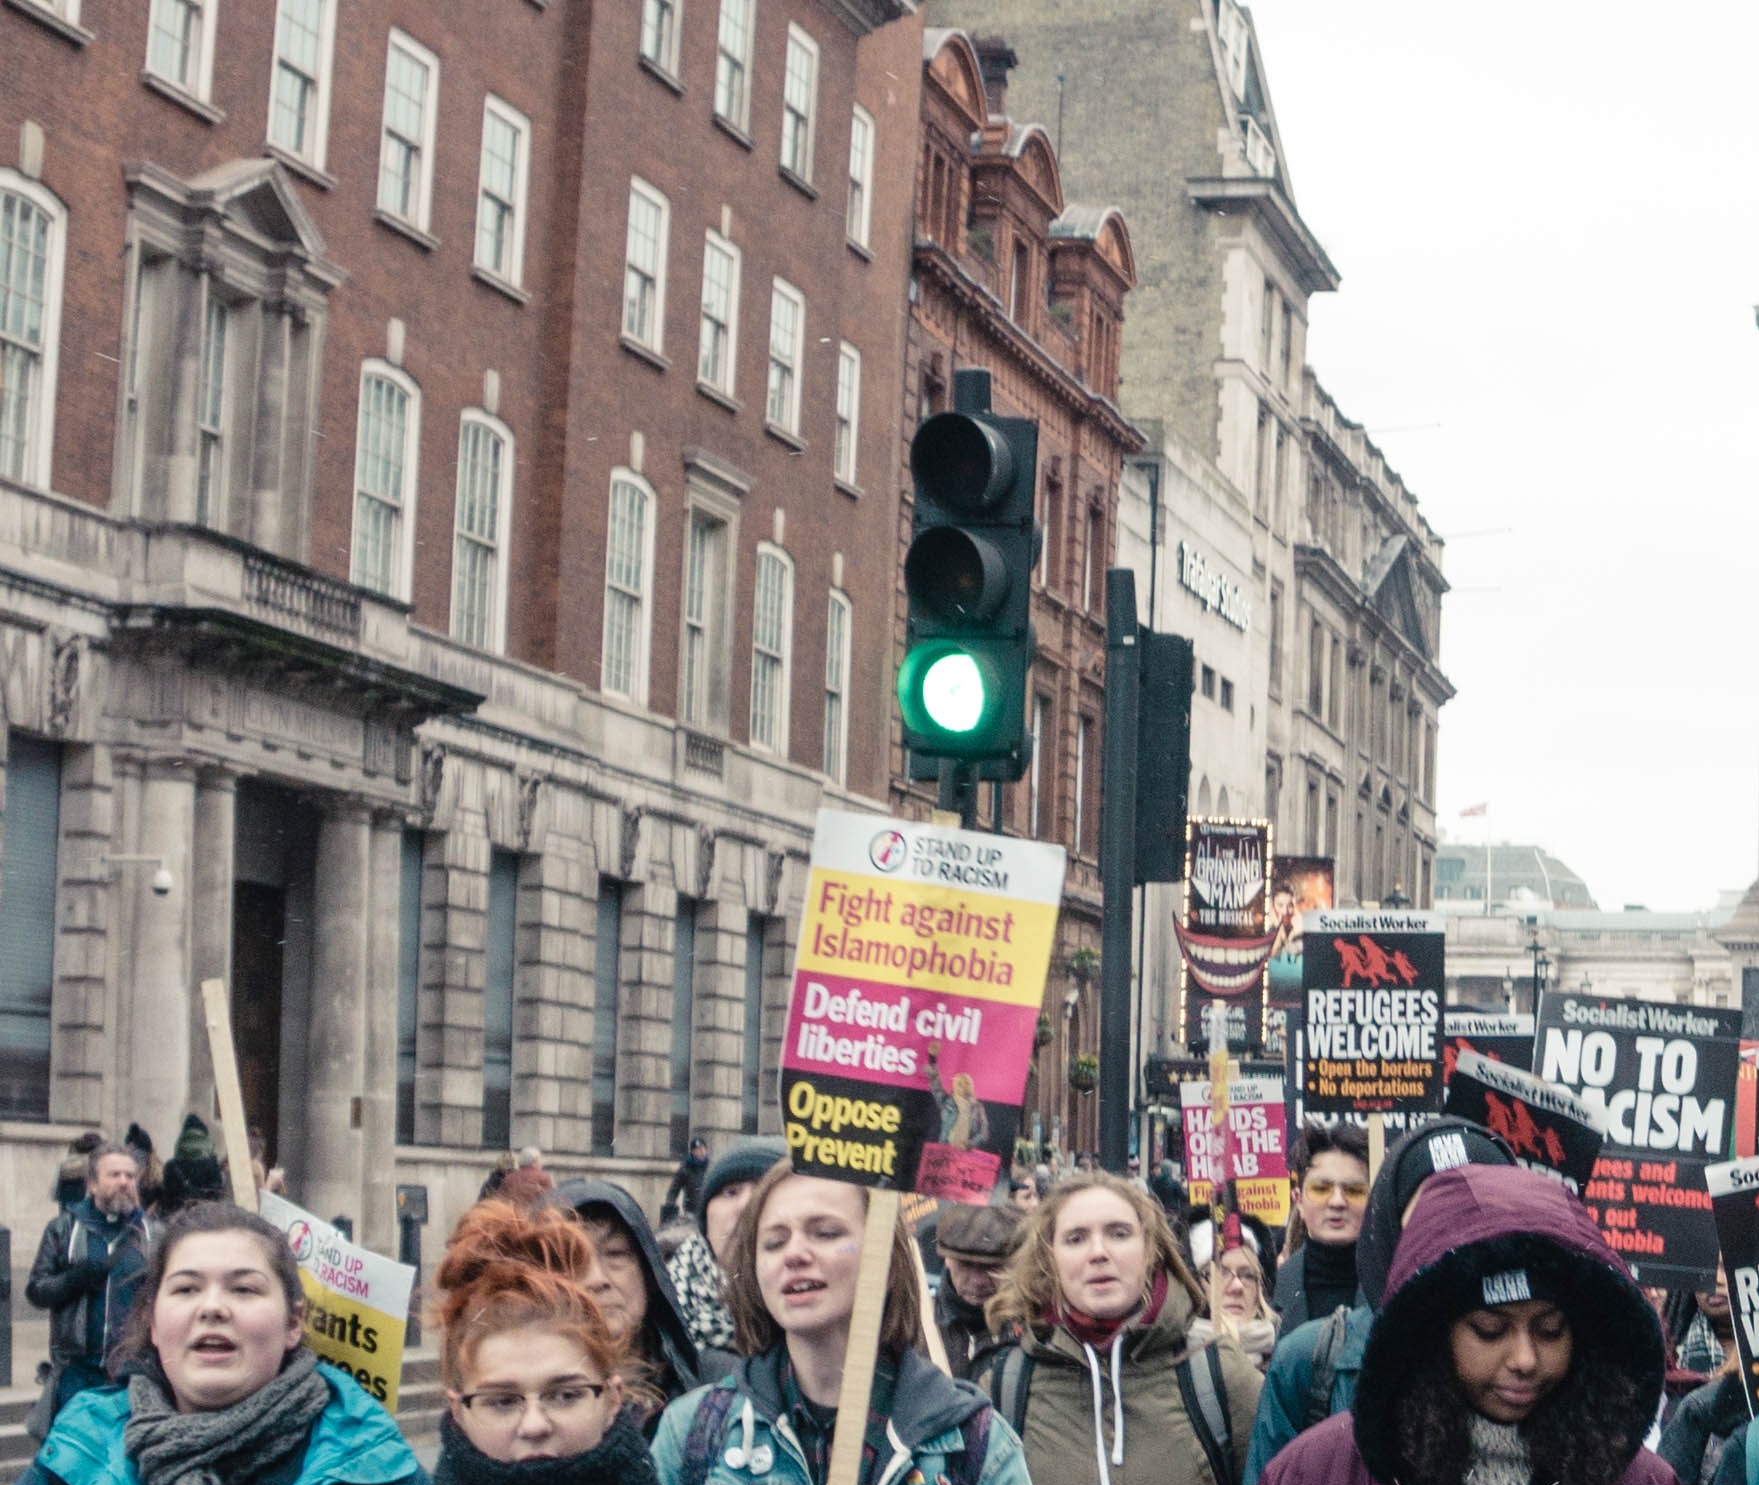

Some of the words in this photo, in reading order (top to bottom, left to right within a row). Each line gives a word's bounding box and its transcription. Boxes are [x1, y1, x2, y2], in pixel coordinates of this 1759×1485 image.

[915, 836, 972, 863] STAND
[976, 847, 1003, 864] UP
[938, 861, 1009, 890] RACISM
[818, 881, 894, 927] Fight
[900, 902, 1015, 944] against
[812, 924, 1014, 986] Islamophobia
[803, 981, 909, 1033] Defend
[915, 1002, 982, 1045] civil
[1307, 988, 1439, 1026] REFUGEES
[797, 1023, 918, 1076] liberties
[1306, 1024, 1437, 1060] WELCOME
[1541, 1027, 1616, 1087] NO
[1635, 1035, 1697, 1095] TO
[1381, 1060, 1432, 1077] borders
[788, 1081, 901, 1134] Oppose
[1319, 1079, 1337, 1096] No
[1341, 1079, 1425, 1099] deportations
[786, 1123, 897, 1176] Prevent
[321, 1265, 370, 1298] RACISM
[344, 1255, 364, 1272] UP
